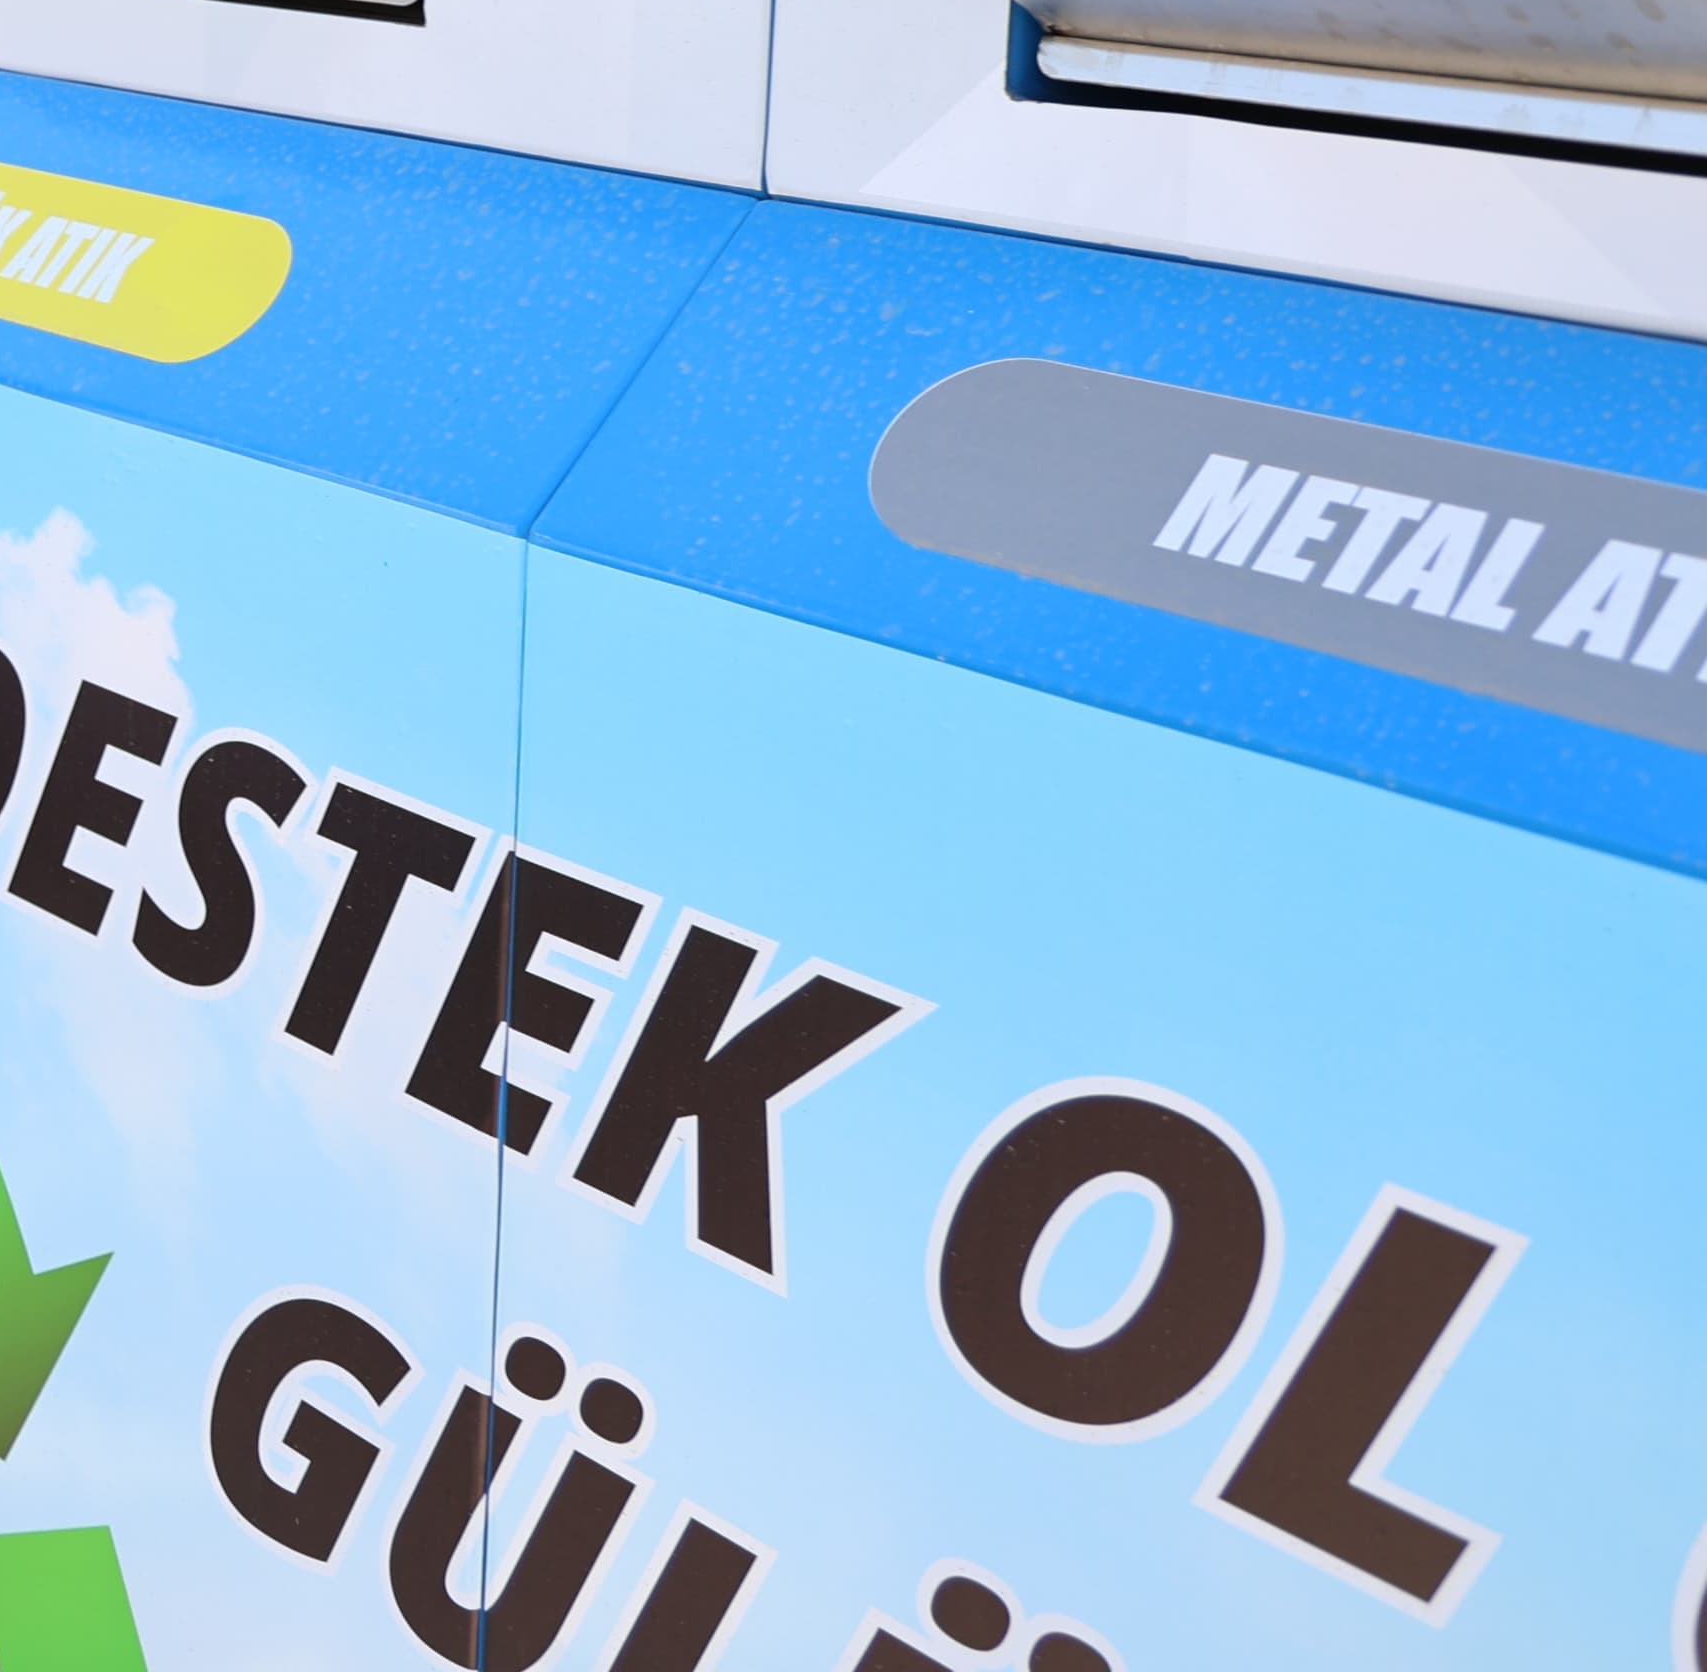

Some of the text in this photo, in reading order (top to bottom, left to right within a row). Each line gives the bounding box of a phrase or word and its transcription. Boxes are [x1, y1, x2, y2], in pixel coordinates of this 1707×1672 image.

[1151, 452, 1707, 684] METAL AT
[937, 1092, 1498, 1605] OL
